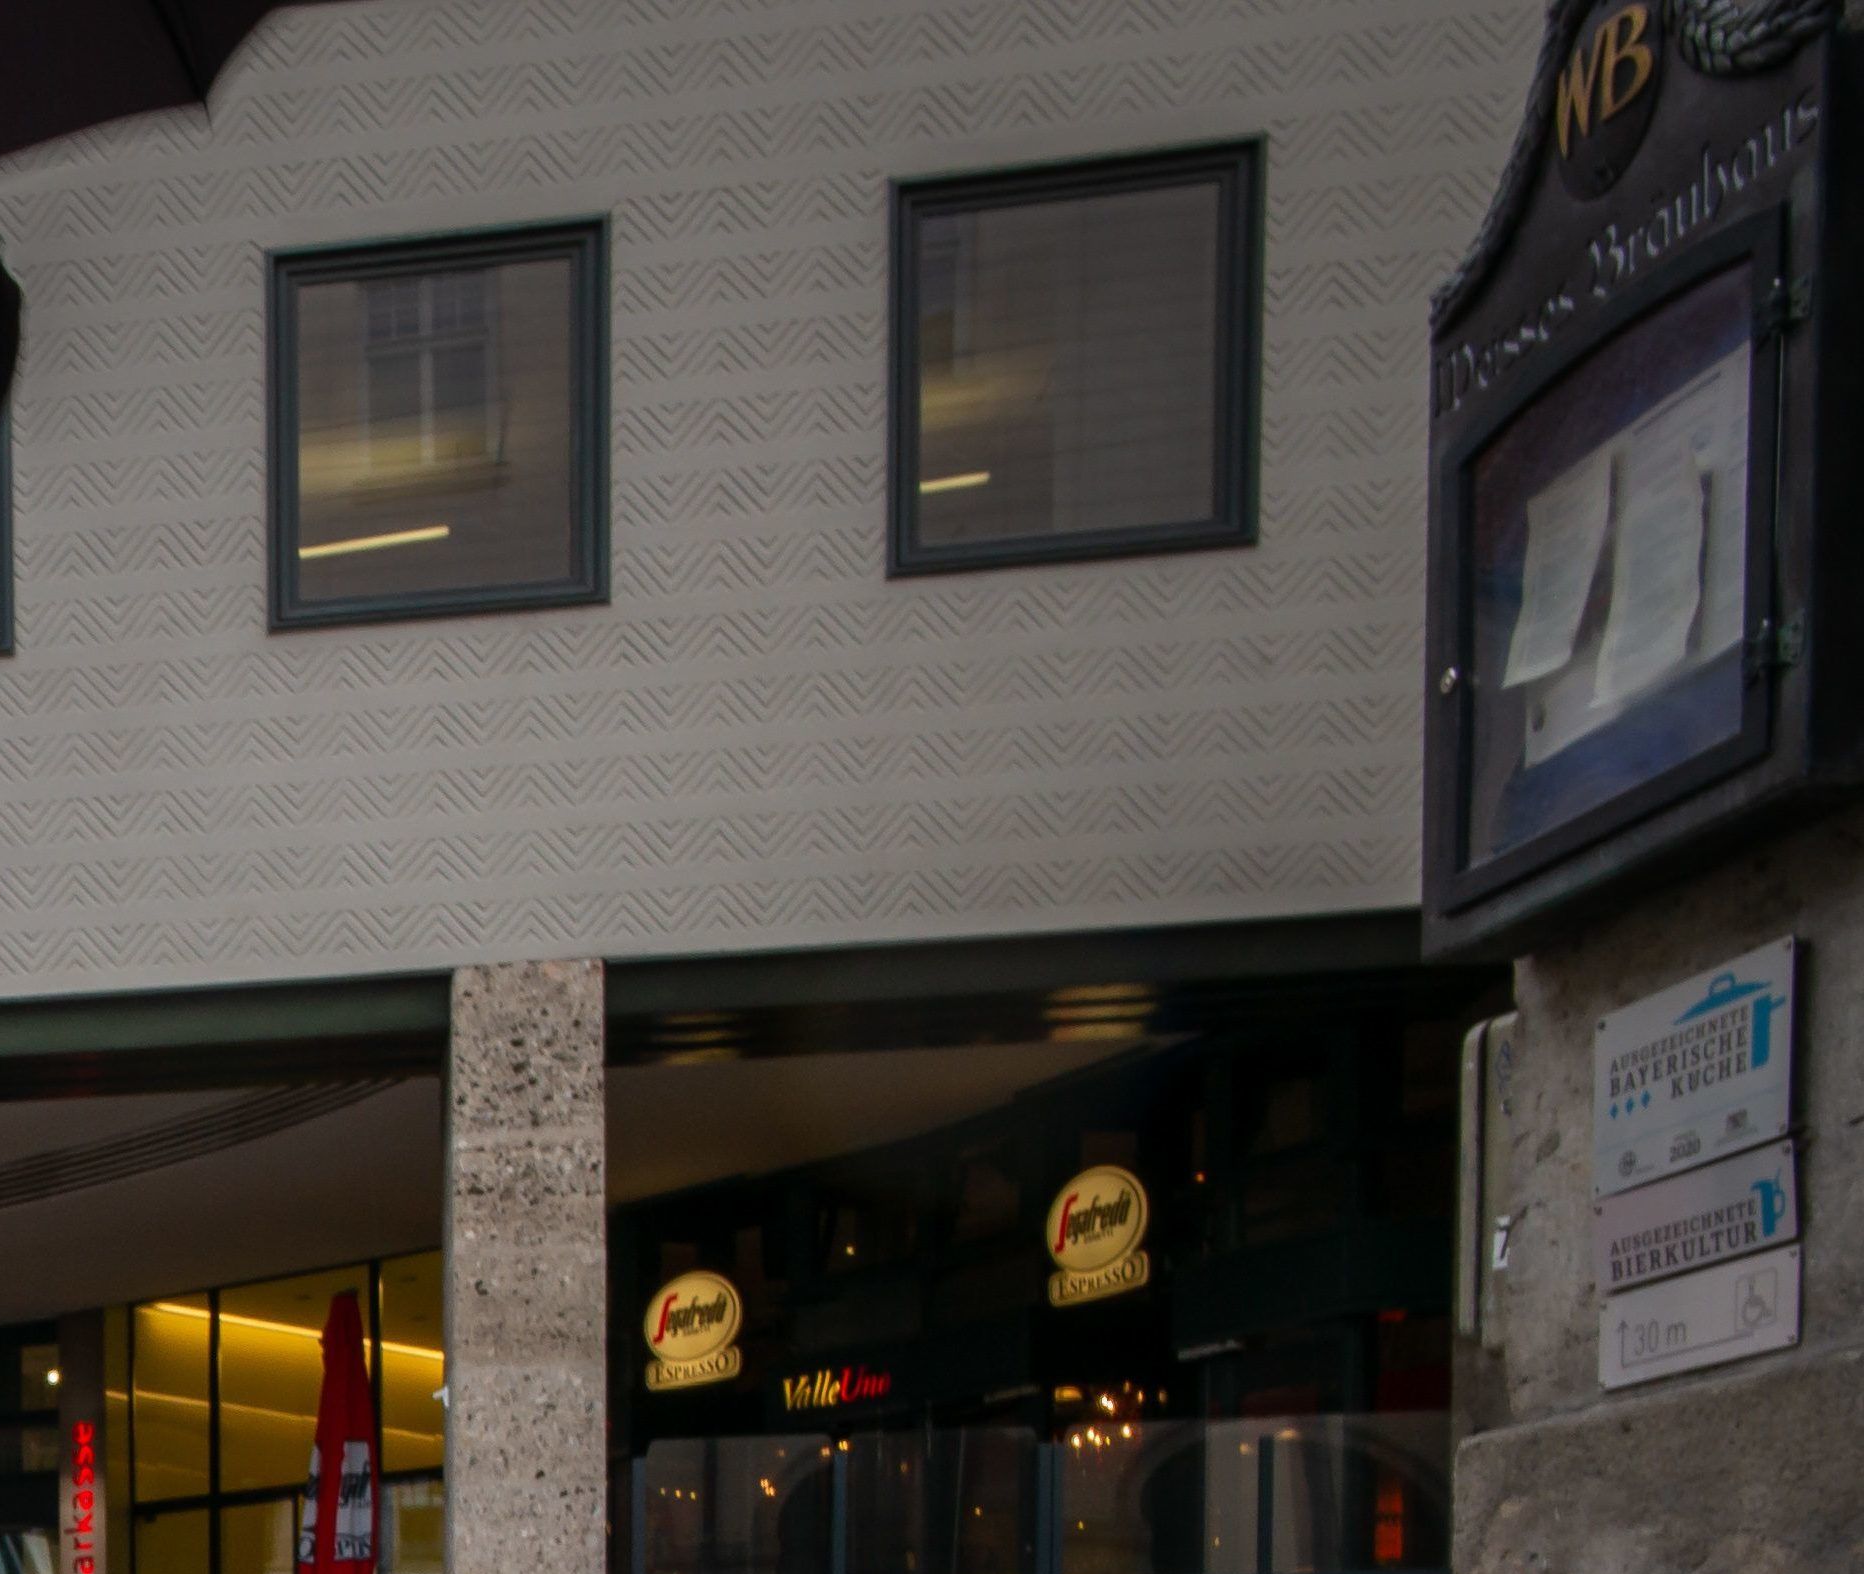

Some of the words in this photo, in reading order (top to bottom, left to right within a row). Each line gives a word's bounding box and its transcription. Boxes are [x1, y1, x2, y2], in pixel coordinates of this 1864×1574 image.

[1557, 4, 1653, 160] WB
[1609, 1025, 1748, 1099] BAYERISCHE
[1610, 1004, 1748, 1075] AUSGEZEICHNETE
[1610, 1198, 1758, 1257] AUSGEZEICHNETE
[1611, 1220, 1759, 1282] BIERKULTUR
[1634, 1318, 1660, 1357] 30
[1666, 1320, 1687, 1346] m
